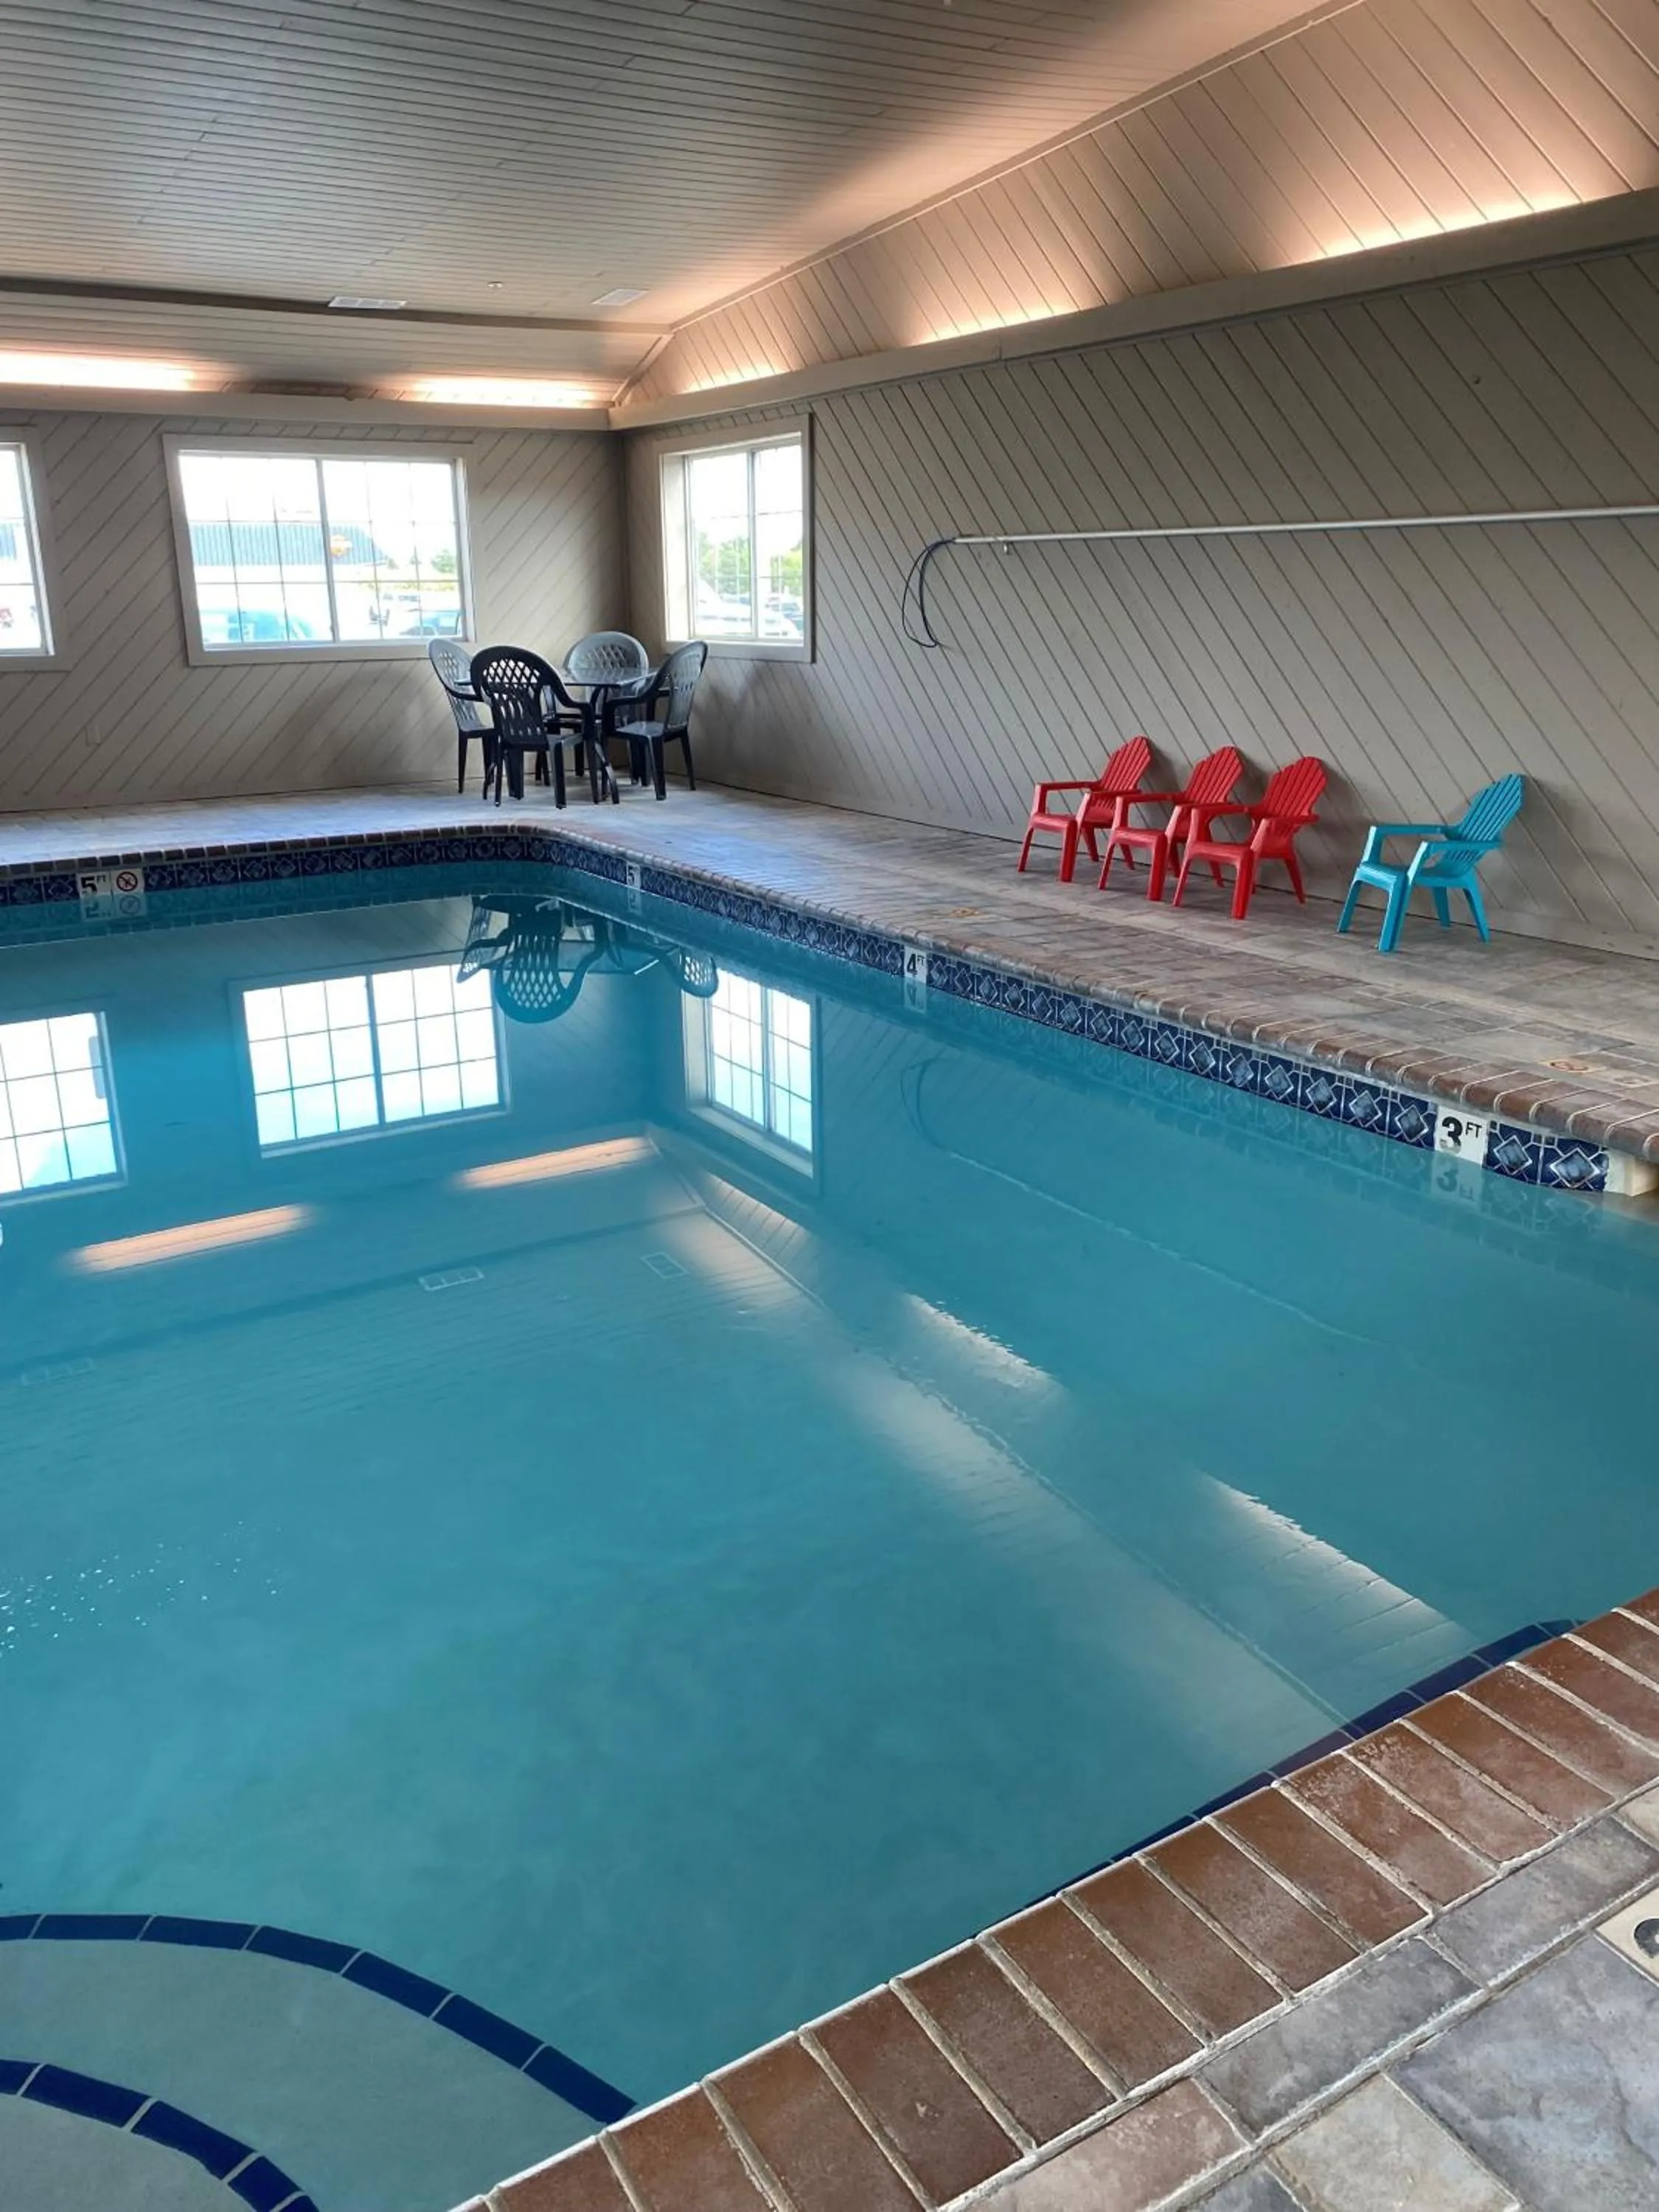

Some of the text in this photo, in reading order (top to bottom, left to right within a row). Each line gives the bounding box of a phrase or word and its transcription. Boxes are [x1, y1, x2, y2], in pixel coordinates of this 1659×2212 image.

[81, 876, 97, 895] 5
[907, 953, 917, 975] 4
[1439, 1116, 1482, 1155] 3 FT
